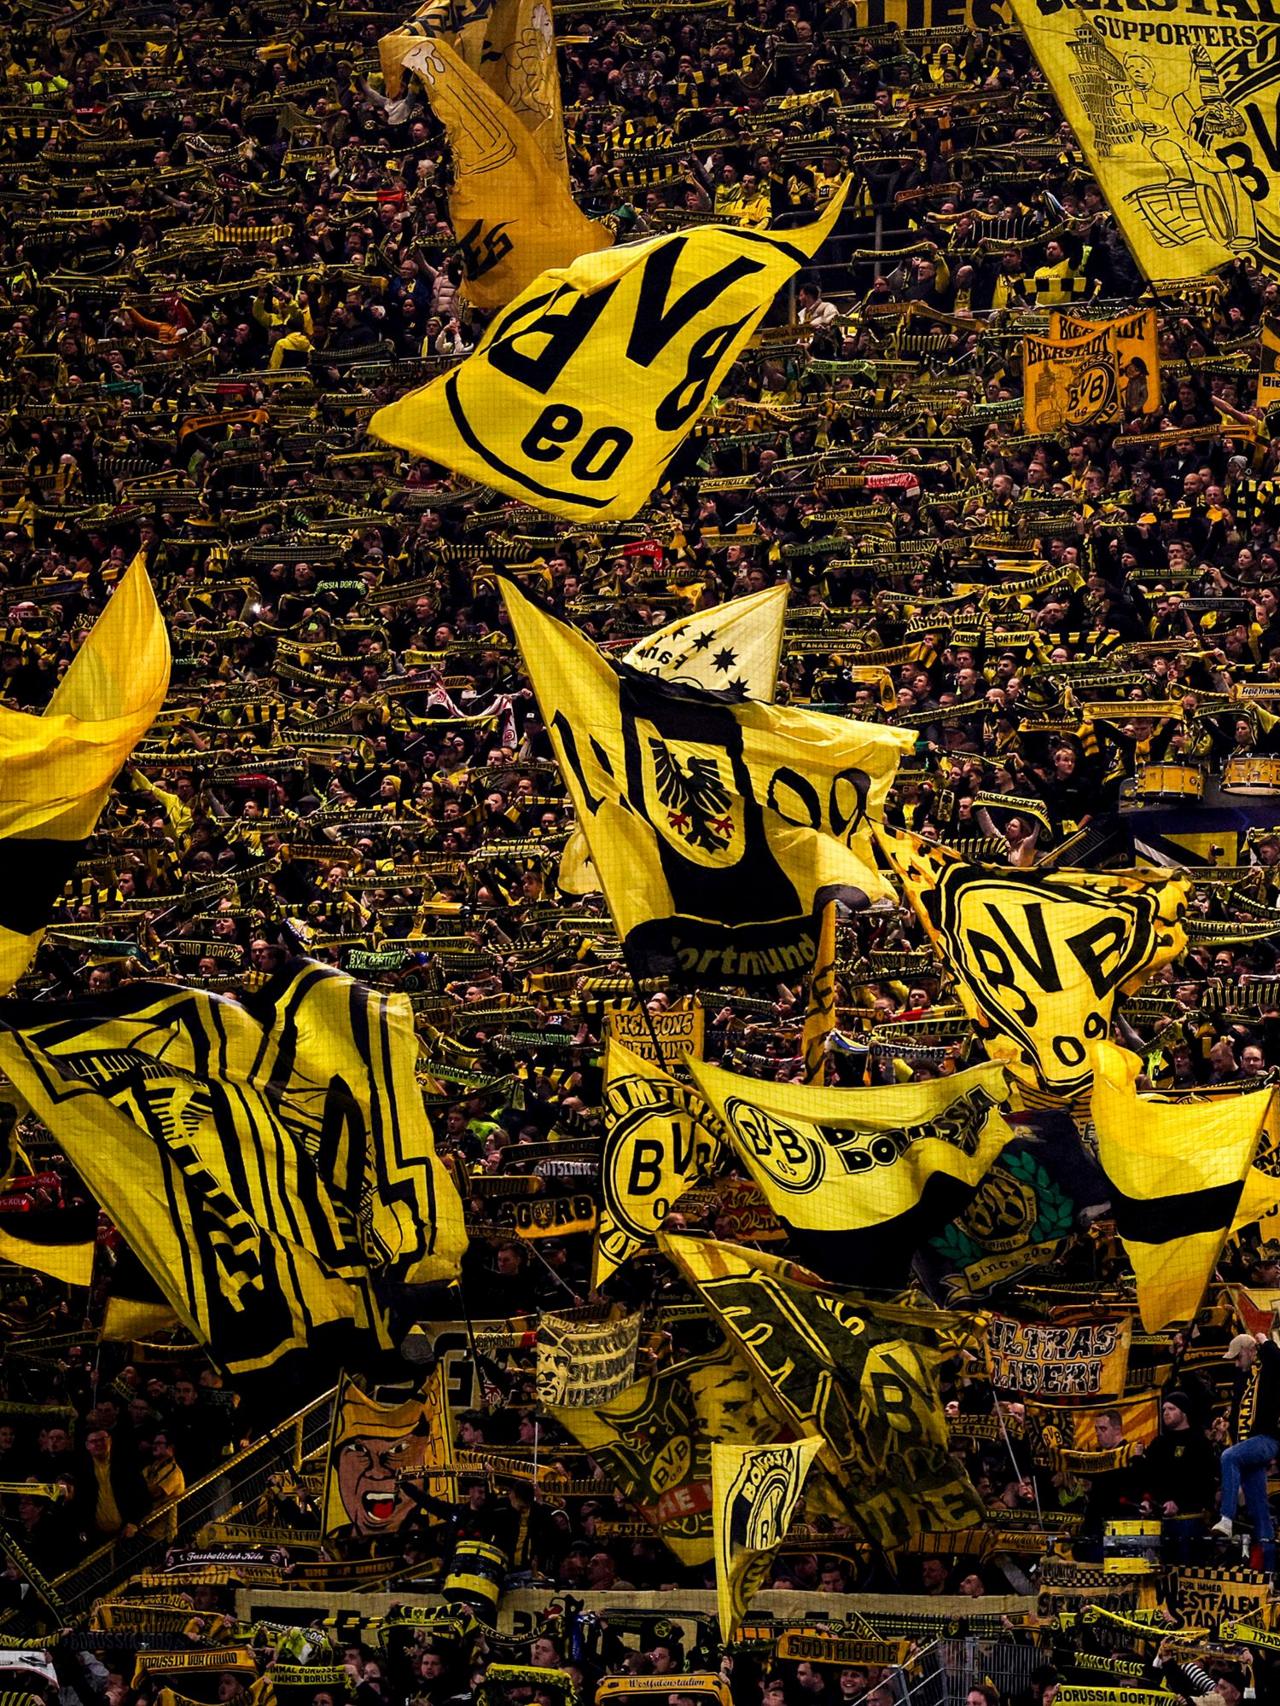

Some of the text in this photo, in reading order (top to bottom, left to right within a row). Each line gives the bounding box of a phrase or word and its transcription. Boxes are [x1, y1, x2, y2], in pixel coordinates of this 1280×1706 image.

[1093, 14, 1260, 48] SUPPORTERS
[1026, 331, 1111, 367] BIERSTADT
[1068, 370, 1105, 413] BVB
[905, 616, 948, 633] RUSSIA
[978, 792, 1011, 804] RUSSIA
[179, 943, 201, 957] SIND
[672, 933, 817, 978] ortmund
[967, 902, 1131, 1027] BVB
[1053, 1011, 1108, 1067] 09
[741, 1115, 809, 1164] BVB
[661, 1306, 711, 1318] RUSSIA
[987, 1320, 1119, 1359] ULTRAS
[991, 1356, 1105, 1394] LIBERI
[1174, 1596, 1260, 1614] ESTFALEN
[187, 1652, 238, 1667] DORTMUND
[1073, 1651, 1146, 1677] MARCO REUS
[273, 1673, 346, 1684] IMMER BORUSSE
[628, 1677, 706, 1689] Westfalenstadion
[1055, 1688, 1180, 1706] BORUSSIA DORTMU
